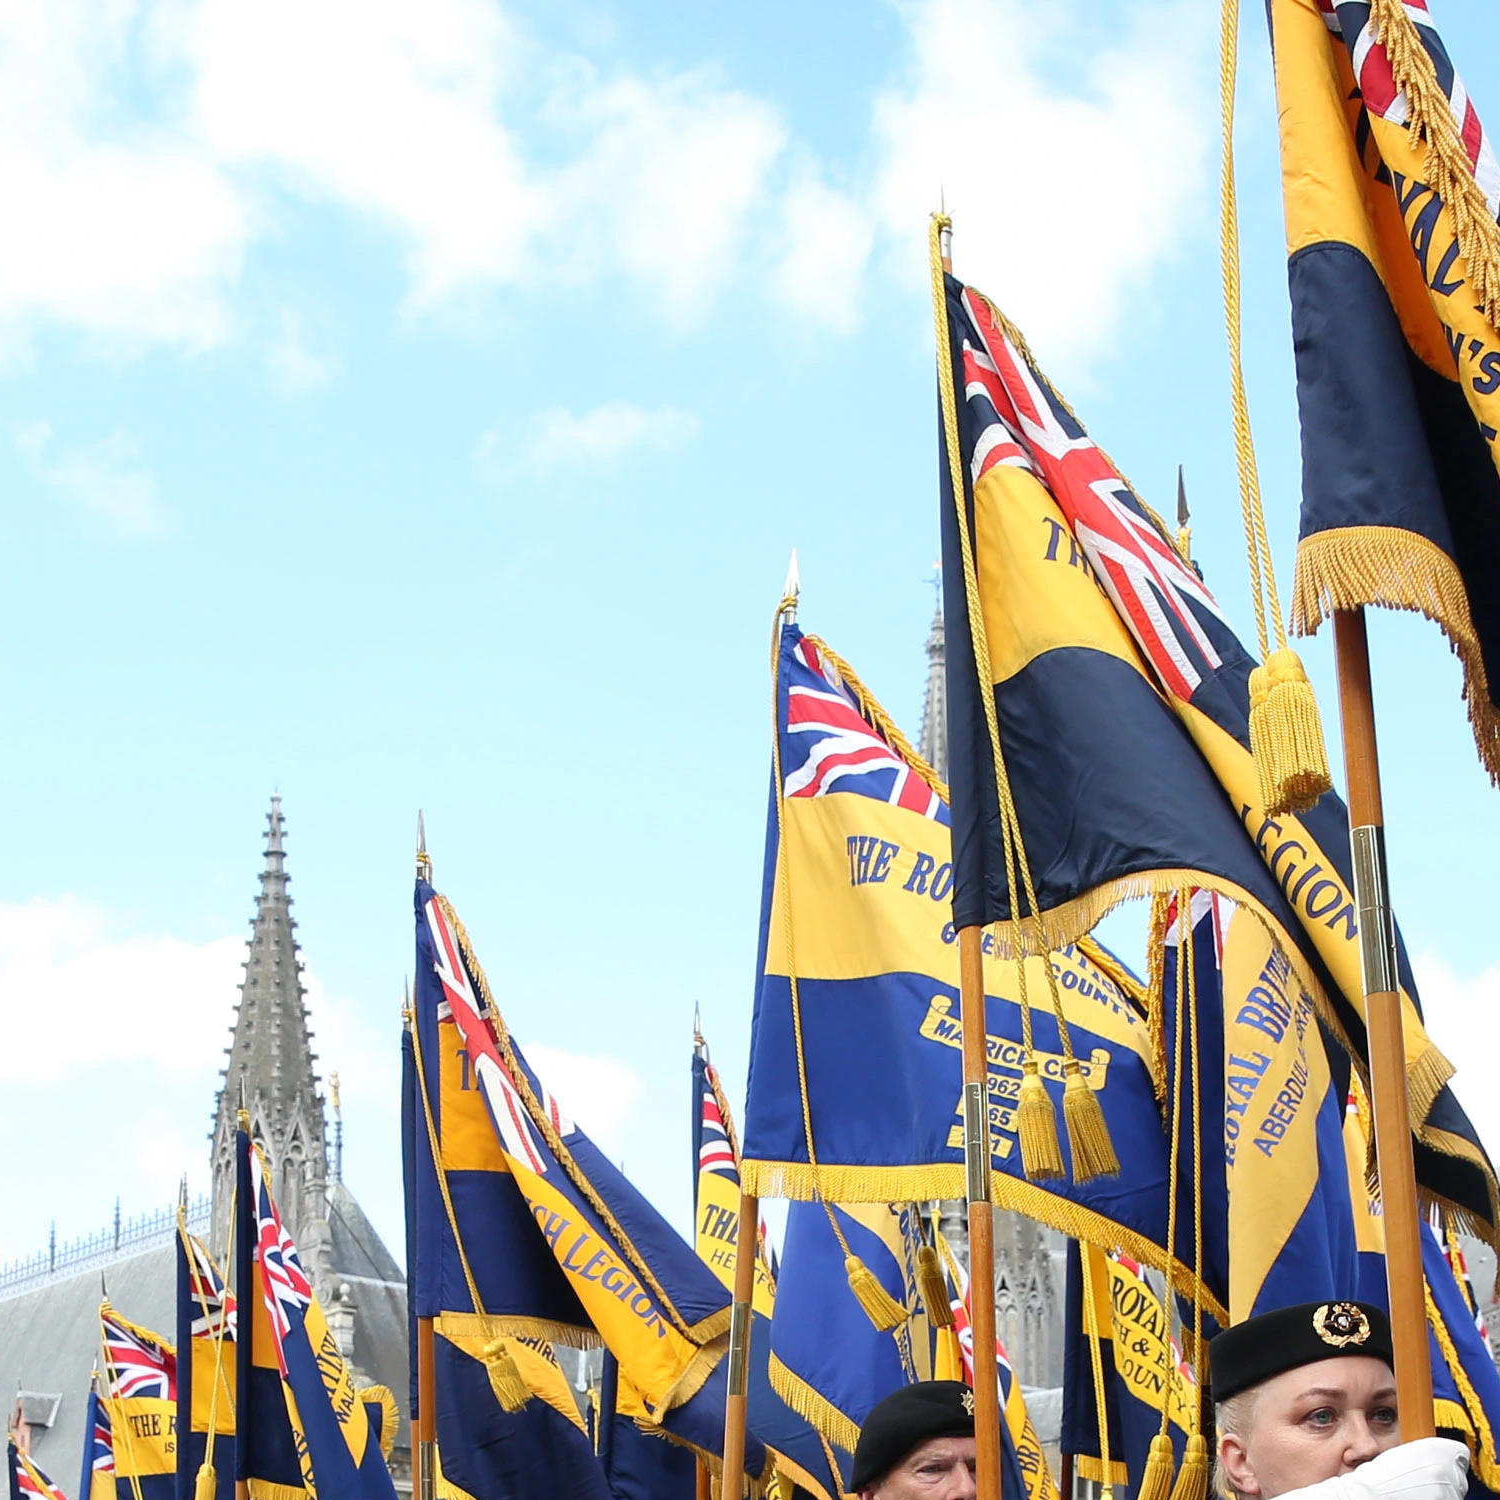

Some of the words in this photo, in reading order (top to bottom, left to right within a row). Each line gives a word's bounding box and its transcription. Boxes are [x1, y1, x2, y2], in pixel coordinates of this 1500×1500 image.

[847, 835, 901, 887] THE
[933, 1018, 1032, 1067] MARICE
[987, 1076, 1021, 1098] 962
[562, 1231, 667, 1339] LEGION
[129, 1413, 162, 1438] THE
